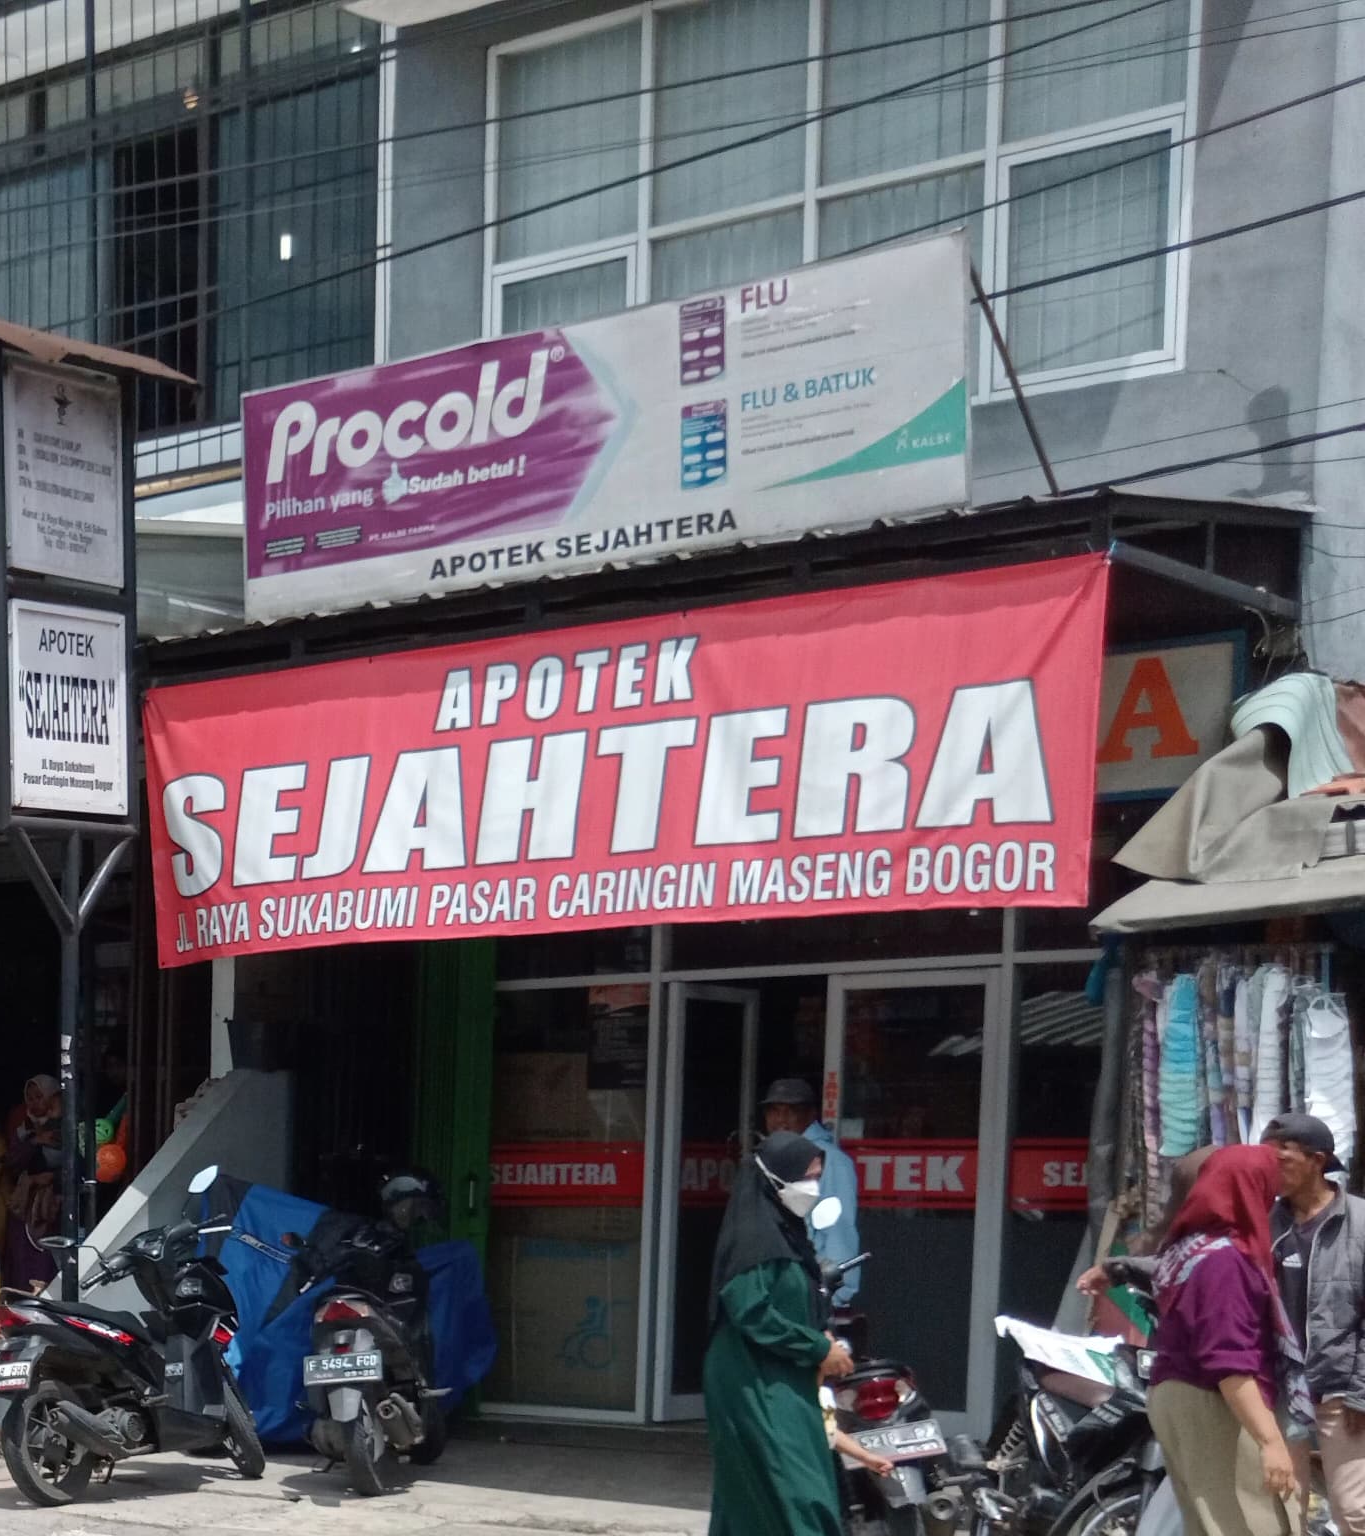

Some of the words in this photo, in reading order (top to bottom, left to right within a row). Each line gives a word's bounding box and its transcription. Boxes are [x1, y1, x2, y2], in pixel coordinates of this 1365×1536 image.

[741, 279, 788, 313] FLU
[741, 388, 776, 411] FLU
[783, 383, 799, 402] &
[805, 367, 876, 399] BATUK
[266, 350, 549, 484] Procold
[265, 497, 325, 521] Pilihan
[330, 487, 374, 512] yang
[408, 469, 464, 495] Sudah
[467, 460, 514, 484] betul
[430, 542, 544, 580] APOTEK
[556, 509, 738, 558] SEJAHTERA
[39, 628, 94, 658] APOTEK
[434, 634, 702, 734] APOTEK
[23, 773, 41, 786] Pasar
[43, 774, 69, 788] Caringin
[95, 779, 113, 792] Bogor
[160, 677, 1056, 900] SEJAHTERA
[195, 902, 251, 948] RAYA
[258, 886, 420, 941] SUKABUMI
[427, 876, 537, 927] PASAR
[547, 860, 717, 920] CARINGIN
[726, 848, 894, 907] MASENG
[903, 841, 1056, 897] BOGOR
[490, 1162, 617, 1186] SEJAHTERA
[857, 1156, 964, 1192] TEK
[309, 1360, 317, 1371] F
